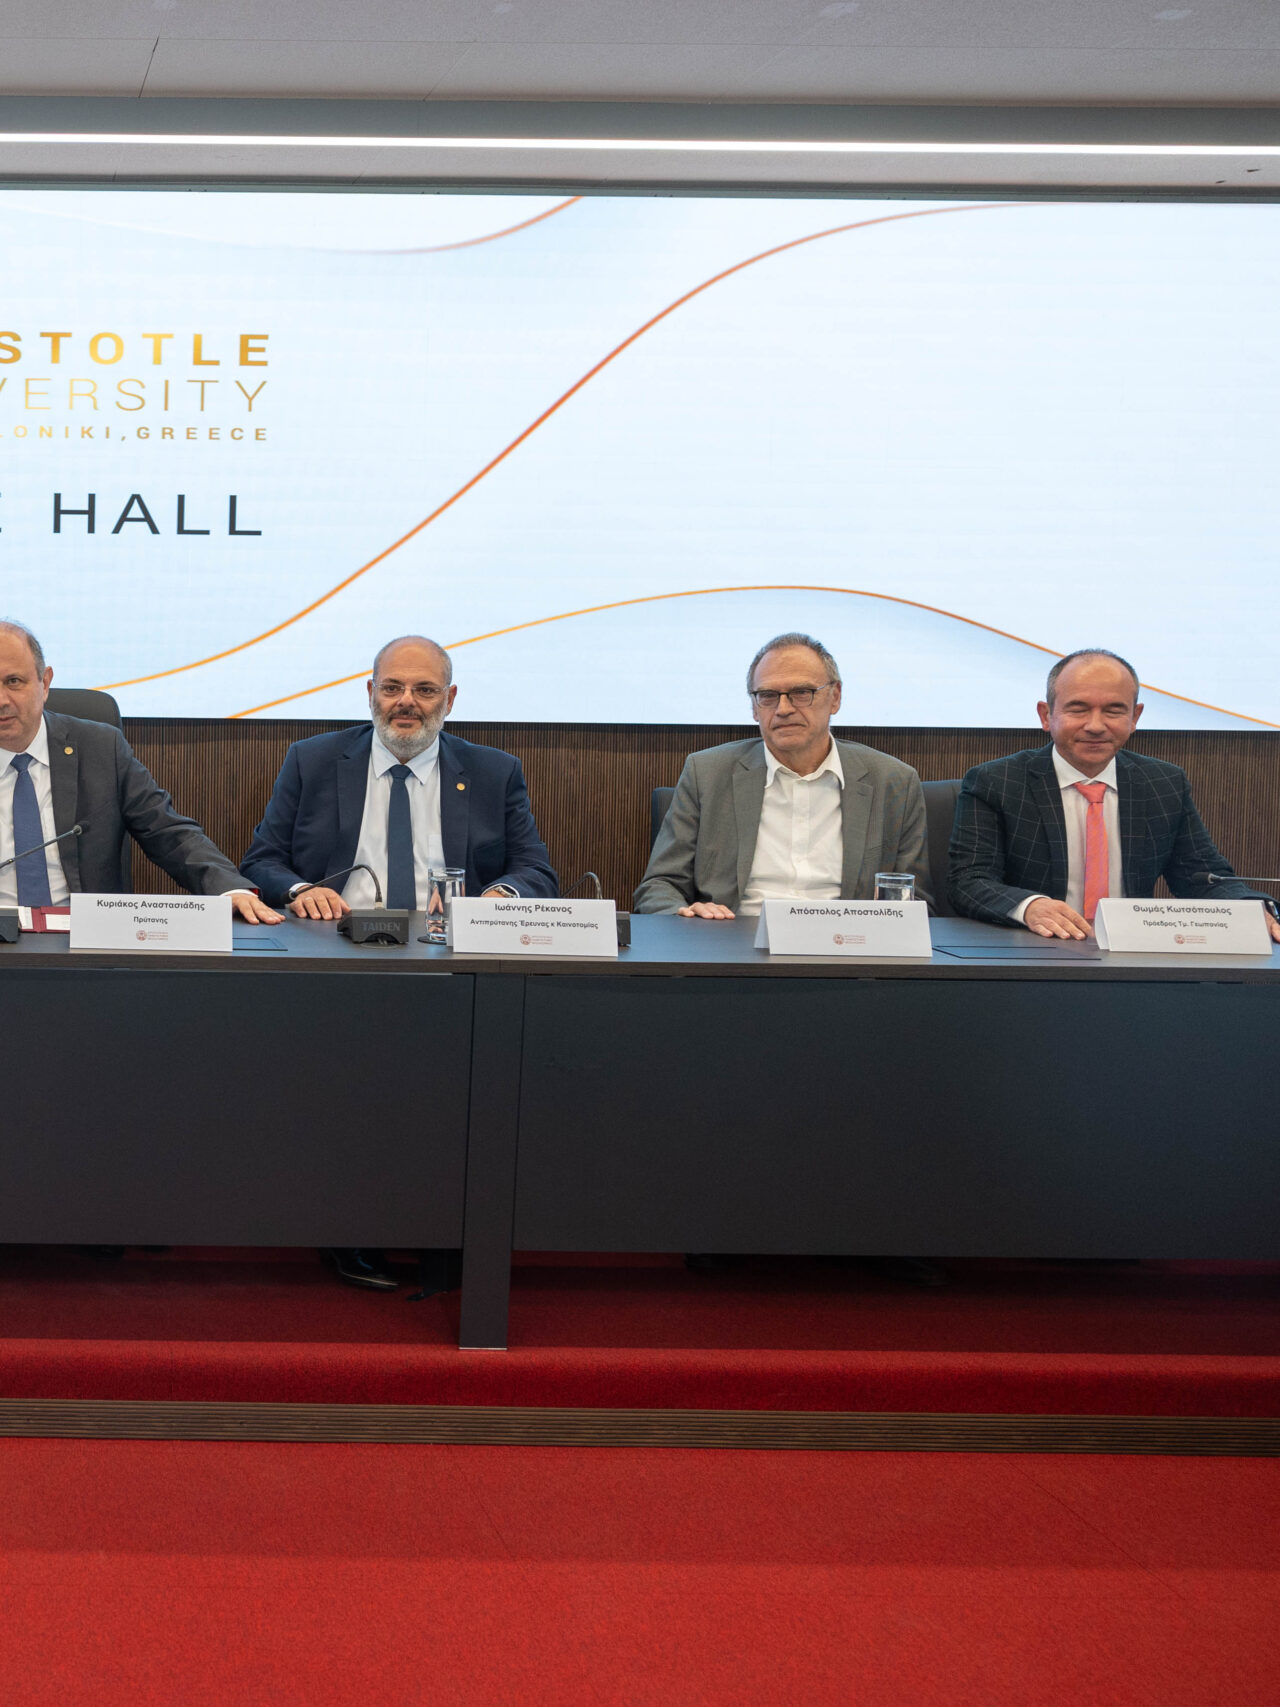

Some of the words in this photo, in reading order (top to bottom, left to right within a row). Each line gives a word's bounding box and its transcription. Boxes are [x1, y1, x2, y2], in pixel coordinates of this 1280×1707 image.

[52, 493, 263, 537] HALL
[96, 899, 138, 909] Κυριάκος
[140, 900, 205, 911] Αναστασιάδης
[494, 903, 532, 914] Ιωάννης
[534, 904, 572, 915] Ρέκανος
[1132, 904, 1165, 914] Θωμάς
[1166, 905, 1232, 916] Κωτσόπουλος
[789, 907, 841, 917] Απόστολος
[843, 908, 904, 918] Αποστολίδης
[133, 916, 168, 925] Πρύτανης
